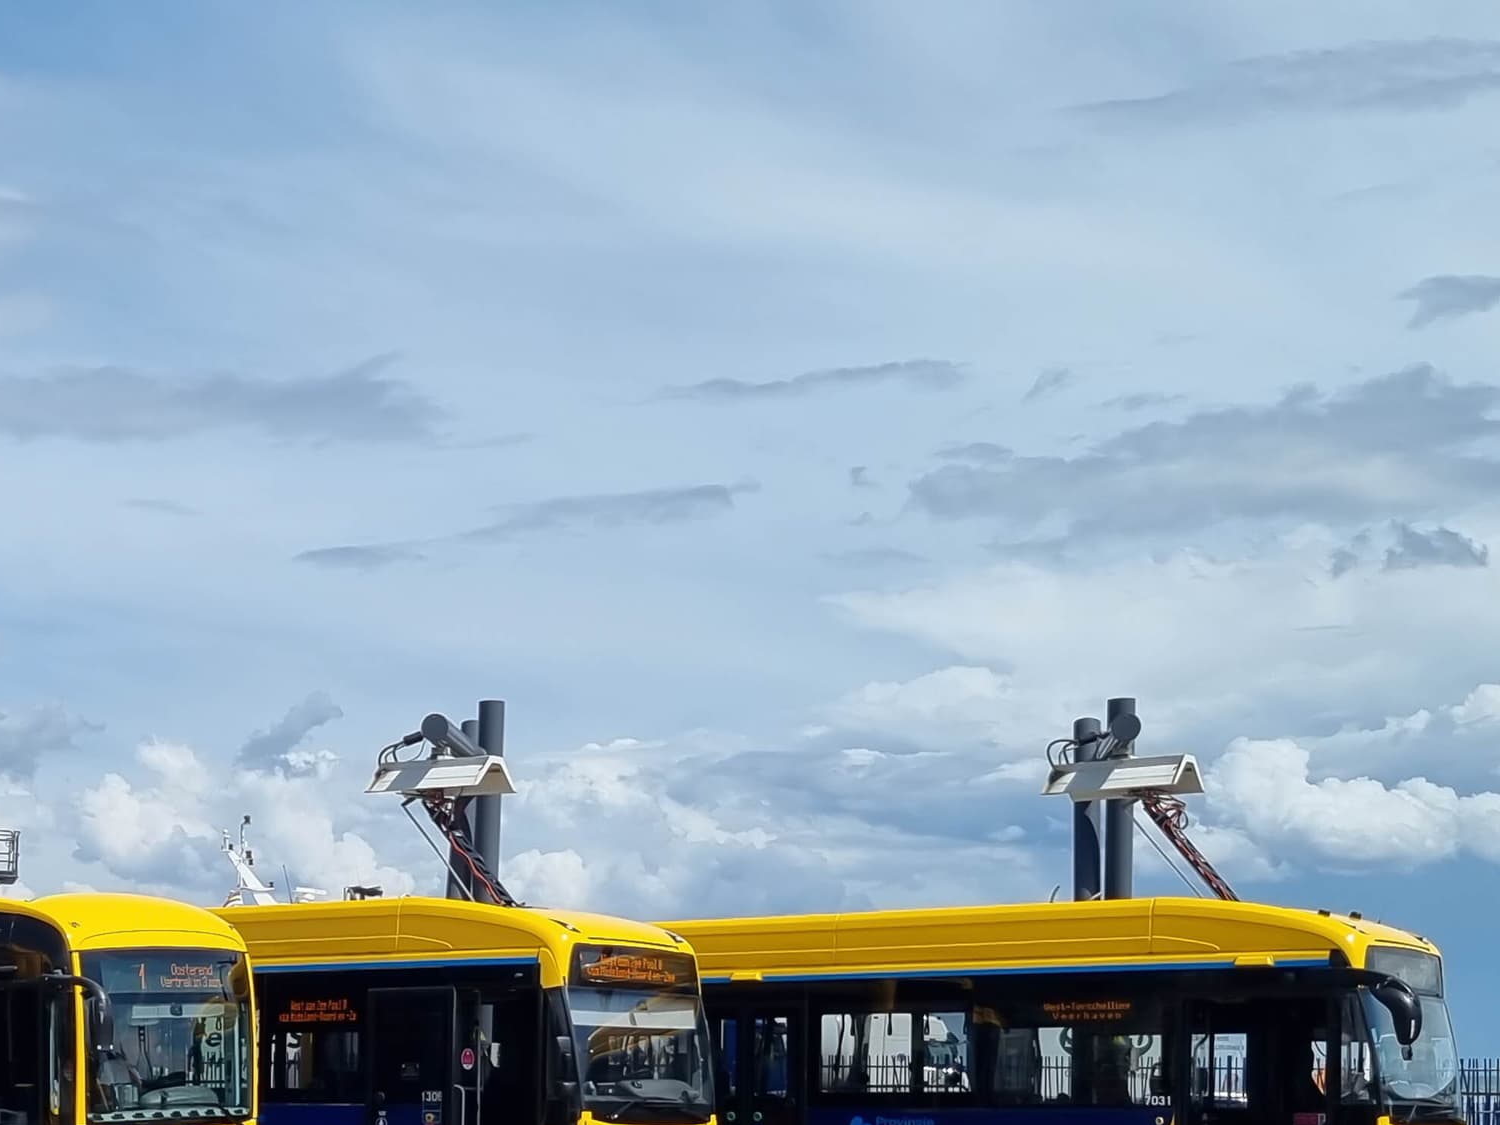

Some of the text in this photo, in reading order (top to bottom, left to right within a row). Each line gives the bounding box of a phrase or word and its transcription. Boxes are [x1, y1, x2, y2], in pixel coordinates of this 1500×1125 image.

[170, 963, 213, 976] Oosterend
[139, 963, 145, 990] 1
[1145, 1095, 1172, 1106] 7031
